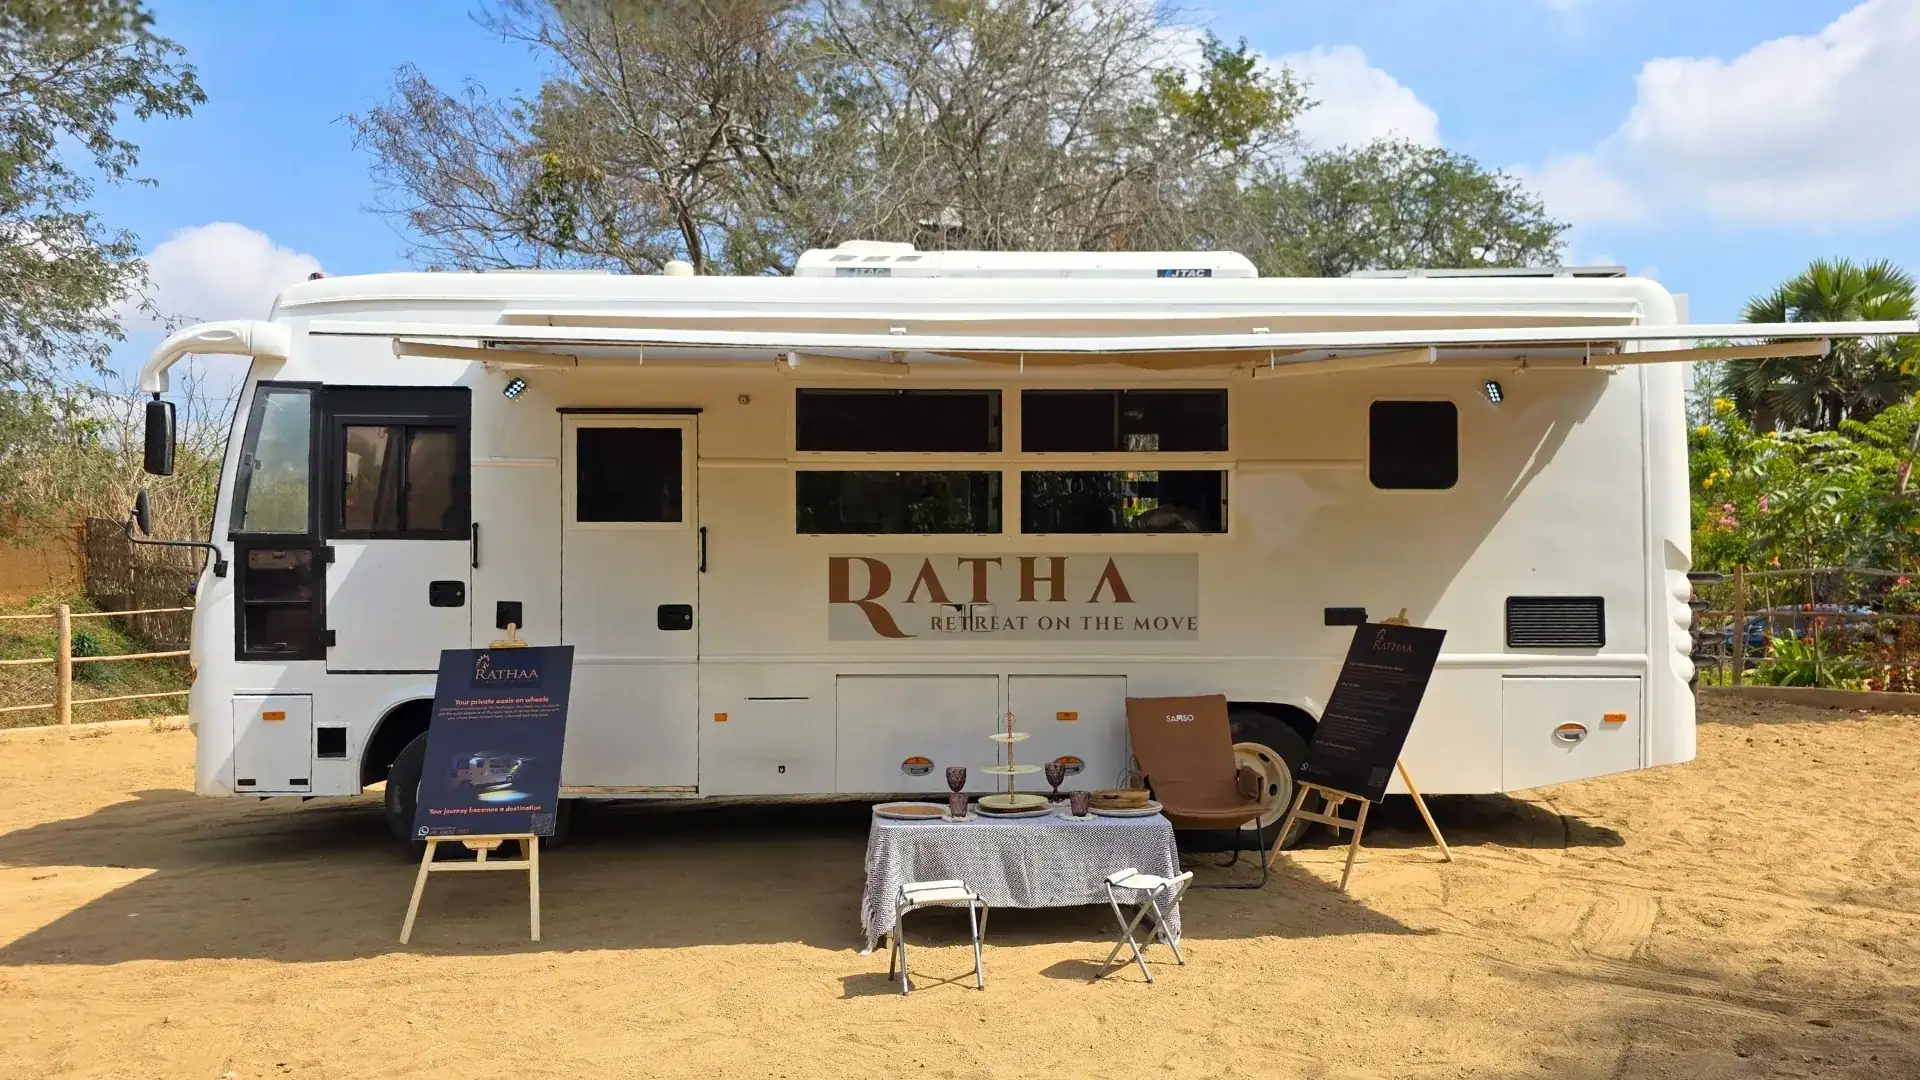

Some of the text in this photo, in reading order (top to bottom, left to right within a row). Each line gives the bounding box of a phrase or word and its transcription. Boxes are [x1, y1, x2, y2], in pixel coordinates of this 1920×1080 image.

[1171, 269, 1206, 277] JTAC
[829, 556, 1137, 638] RATHA
[930, 615, 1199, 632] RETREAT ON THE MOVE
[1373, 640, 1412, 653] RATHAA
[475, 668, 539, 680] RATHAA
[471, 697, 494, 707] private
[525, 695, 549, 703] wheels
[1165, 713, 1195, 723] SAMSO
[443, 807, 468, 816] journey
[505, 804, 541, 812] destination
